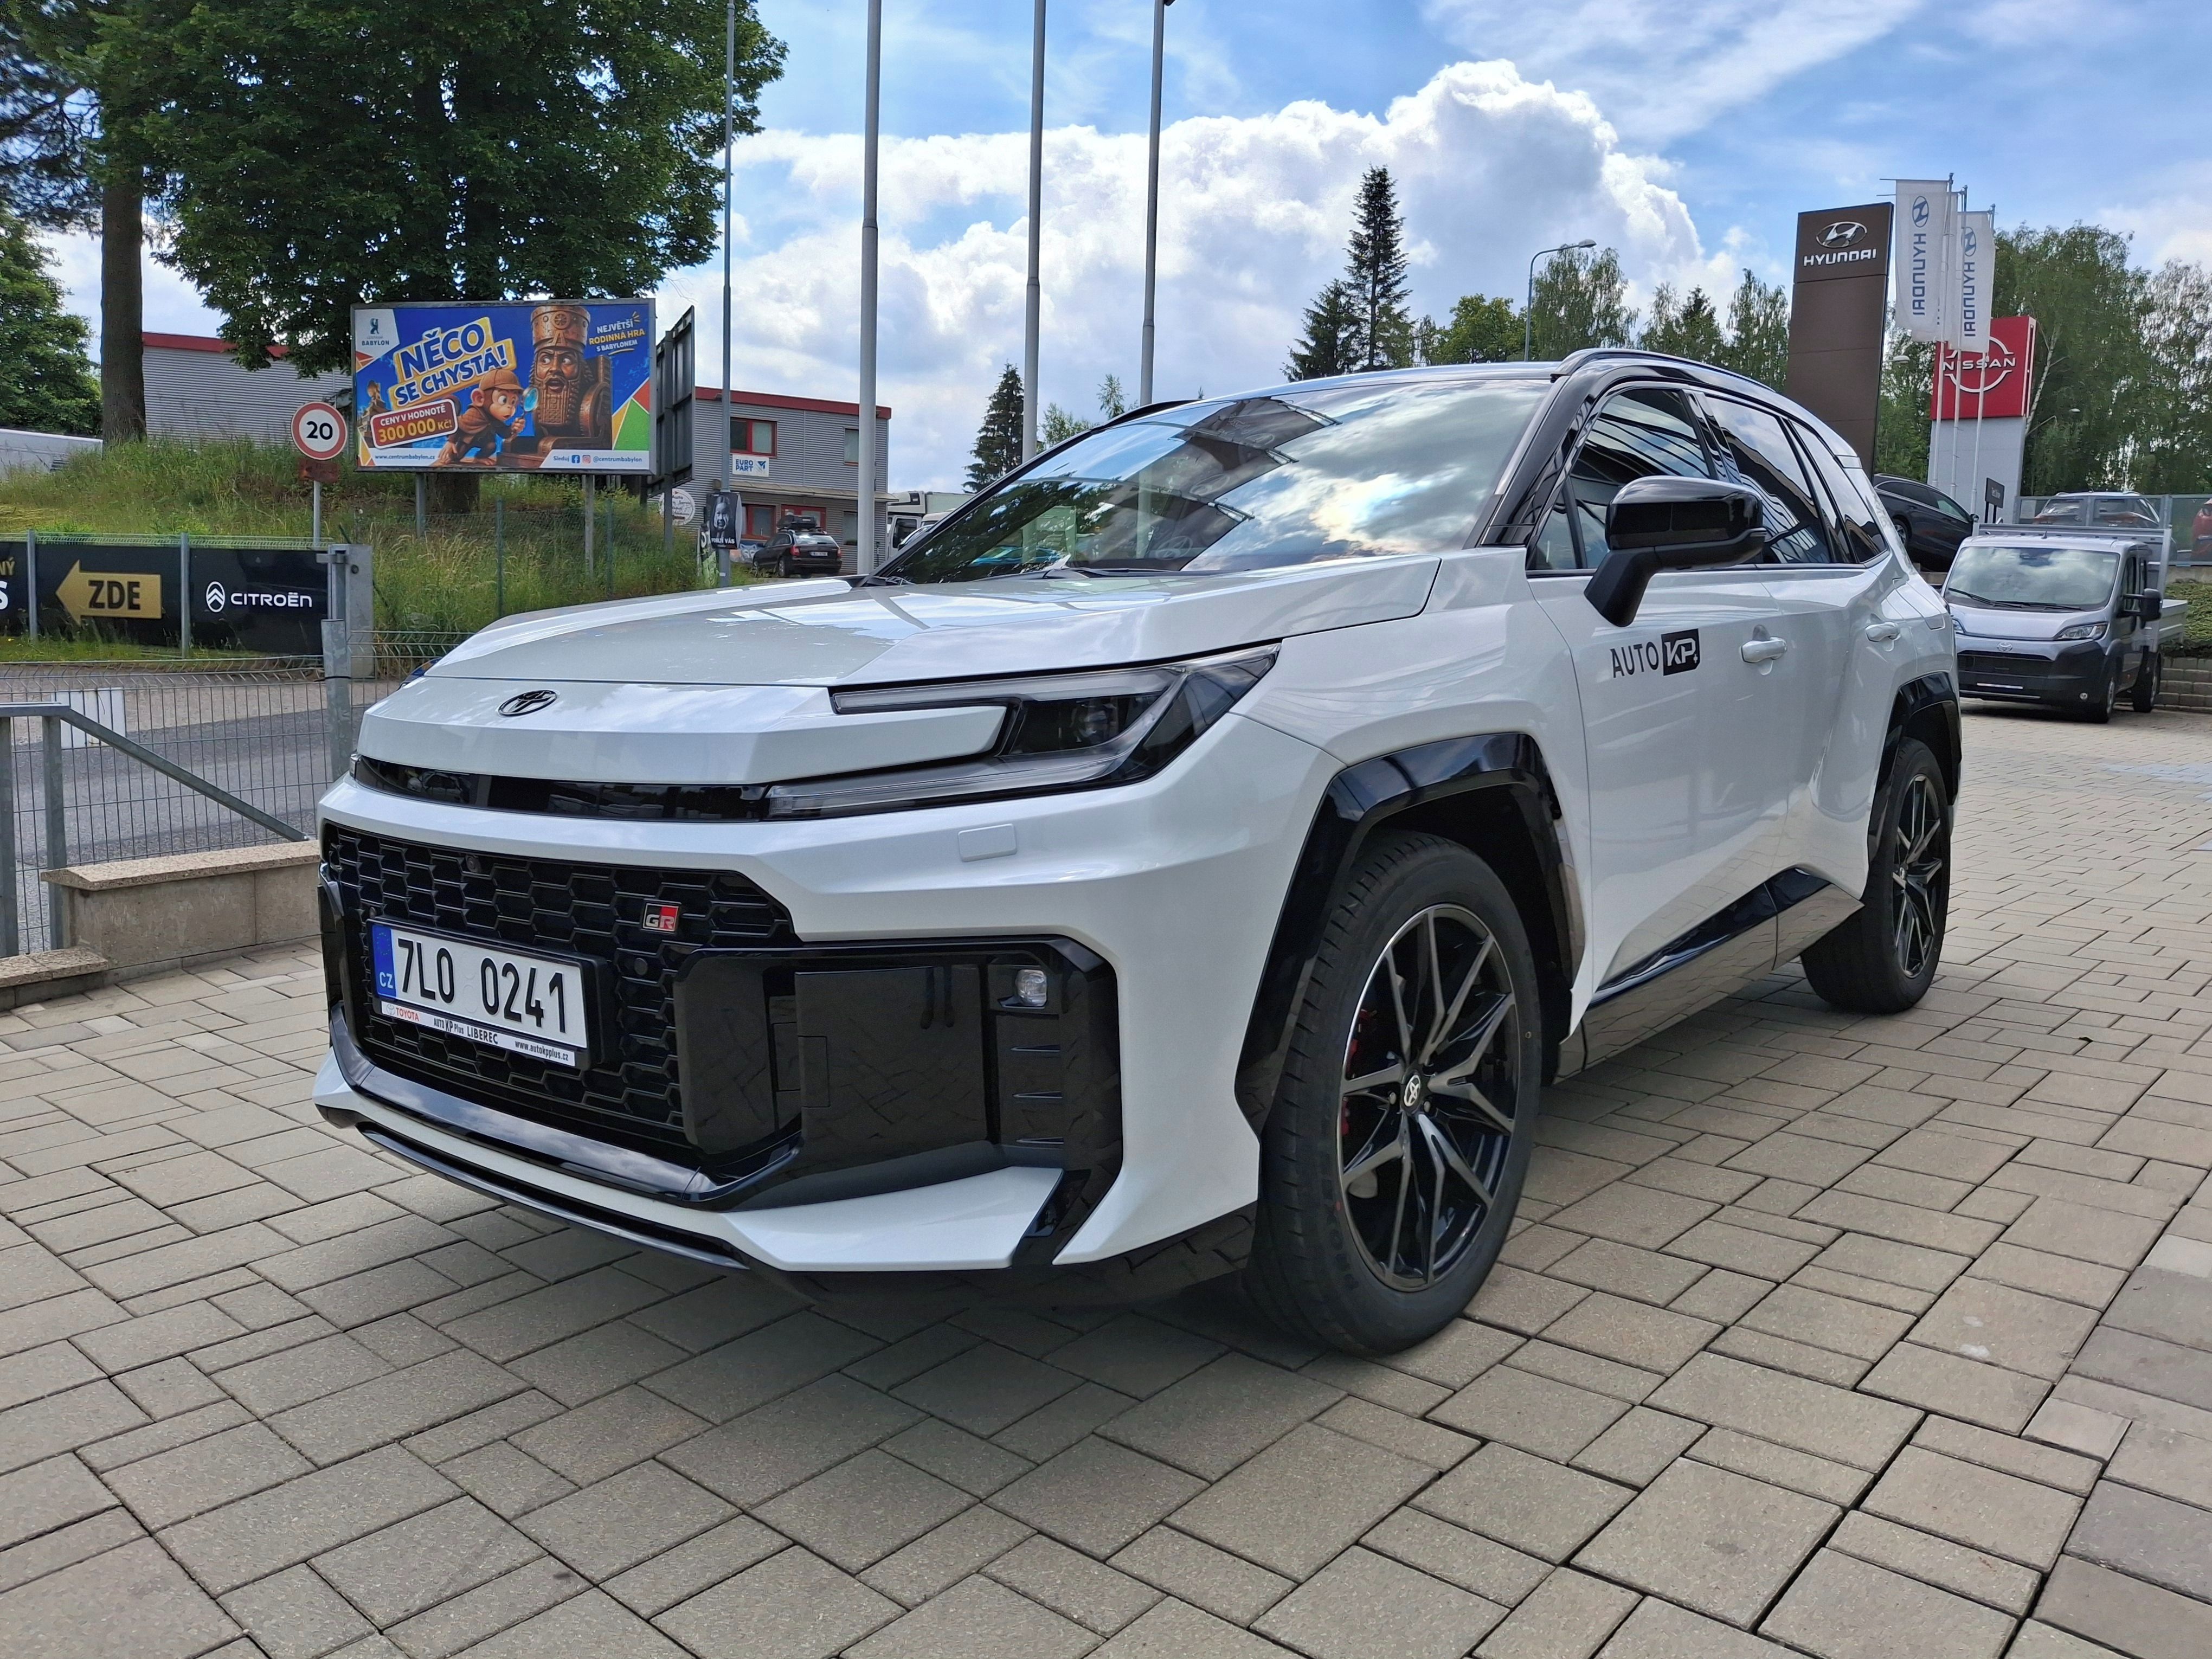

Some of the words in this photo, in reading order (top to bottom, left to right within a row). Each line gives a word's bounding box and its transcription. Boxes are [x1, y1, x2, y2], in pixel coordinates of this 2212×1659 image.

[1804, 248, 1876, 266] HYUNDAI
[596, 318, 633, 333] NEJVĚTŠÍ
[589, 330, 626, 345] RODINNÁ
[627, 328, 645, 338] HRA
[601, 339, 638, 351] BABYLONEM
[400, 323, 485, 379] NĚCO
[1942, 357, 2016, 371] NSSAN
[395, 381, 420, 405] SE
[421, 344, 509, 394] CHYSTÁ!
[380, 415, 401, 427] CENY
[401, 413, 407, 422] V
[407, 404, 446, 421] HODNOTĚ
[306, 421, 333, 440] 20
[378, 425, 406, 443] 300
[407, 418, 436, 436] 000
[88, 580, 141, 610] ZDE
[230, 592, 313, 608] CITROËN
[1610, 641, 1659, 678] AUTO
[645, 914, 675, 929] GR
[379, 972, 394, 989] CZ
[480, 957, 566, 1034] 0241
[395, 1007, 420, 1022] TOYOTA
[434, 1018, 445, 1029] AUTO
[445, 1019, 453, 1033] KP
[454, 1023, 464, 1035] Plus
[467, 1026, 498, 1045] LIBEREC
[514, 1040, 569, 1062] www.autokpplus.cz
